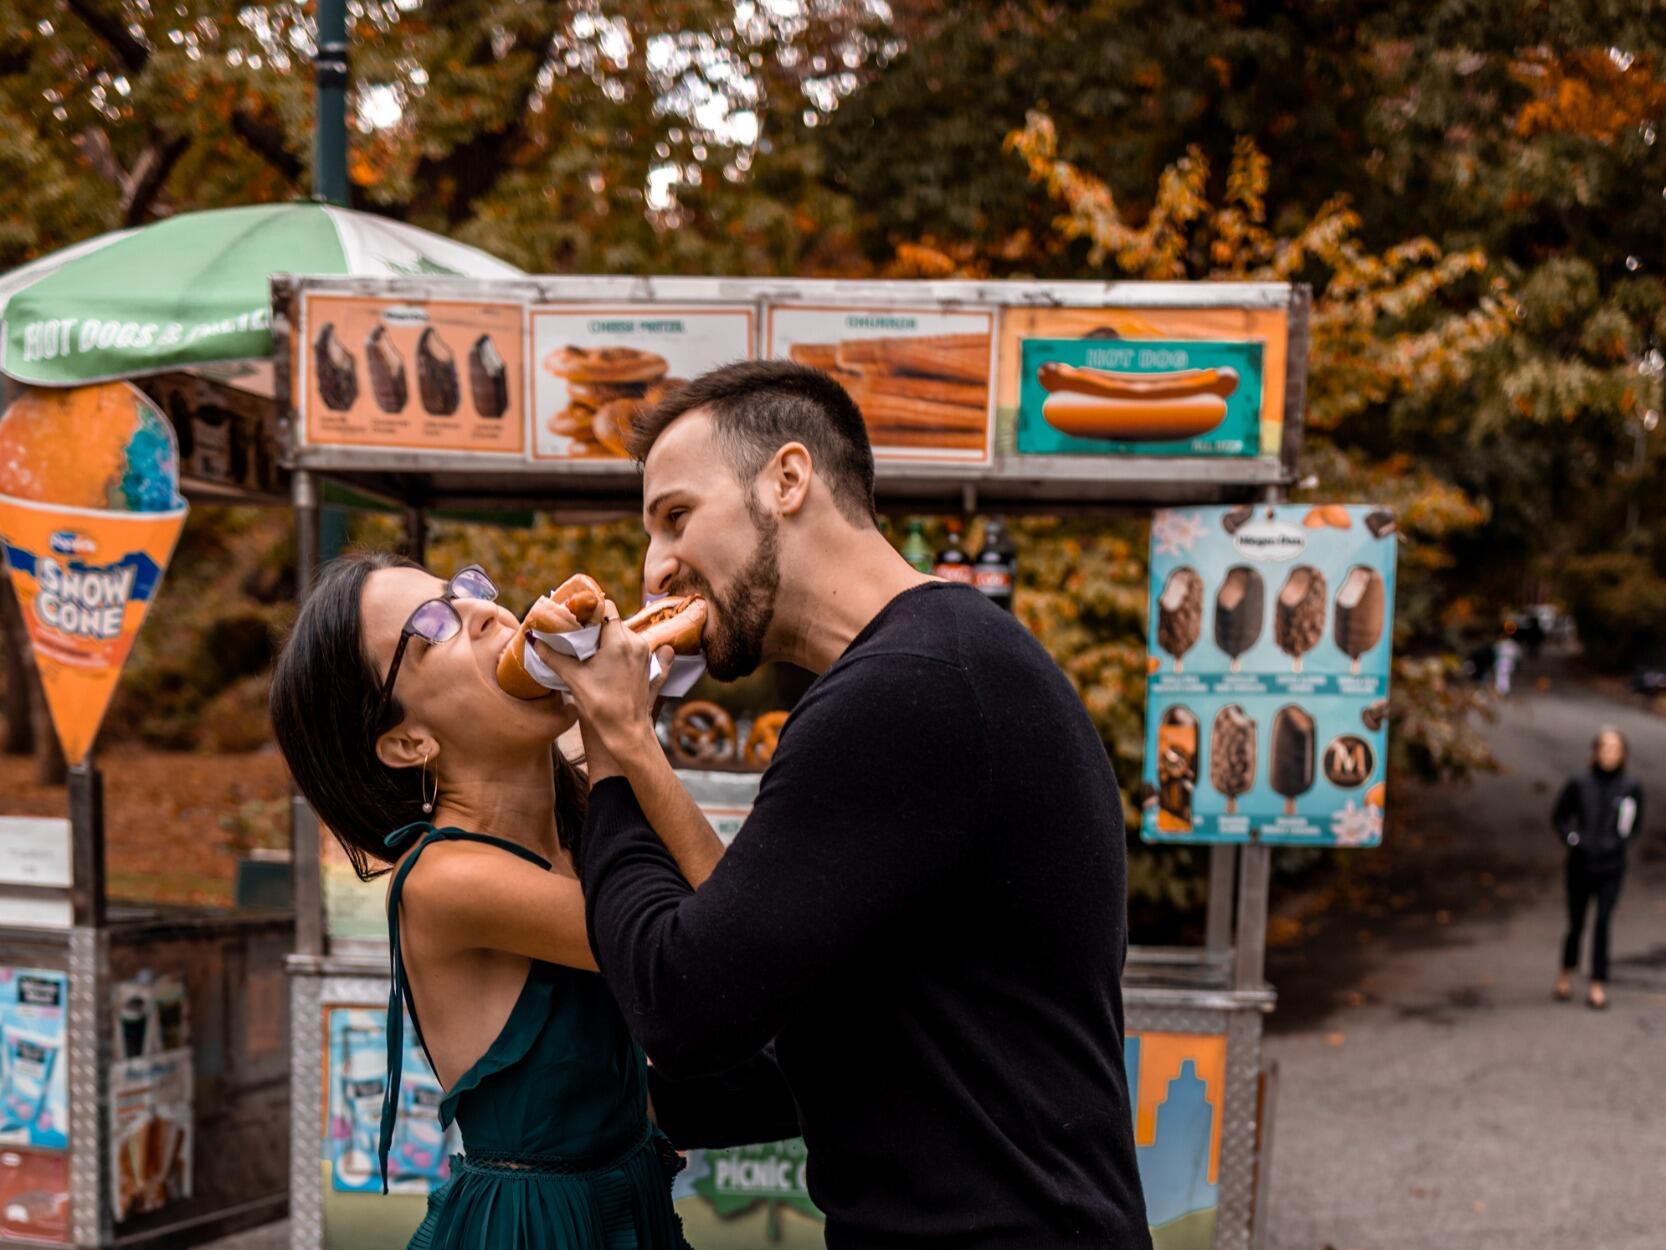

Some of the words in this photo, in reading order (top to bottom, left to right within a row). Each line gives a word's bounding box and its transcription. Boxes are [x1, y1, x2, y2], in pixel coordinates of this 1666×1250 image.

[24, 317, 78, 362] HOT
[78, 318, 159, 352] DOGS
[1086, 348, 1135, 368] HOT
[1138, 348, 1189, 368] DOG
[38, 557, 137, 607] SNOW
[36, 592, 124, 639] CONE
[716, 1156, 792, 1191] PICNIC
